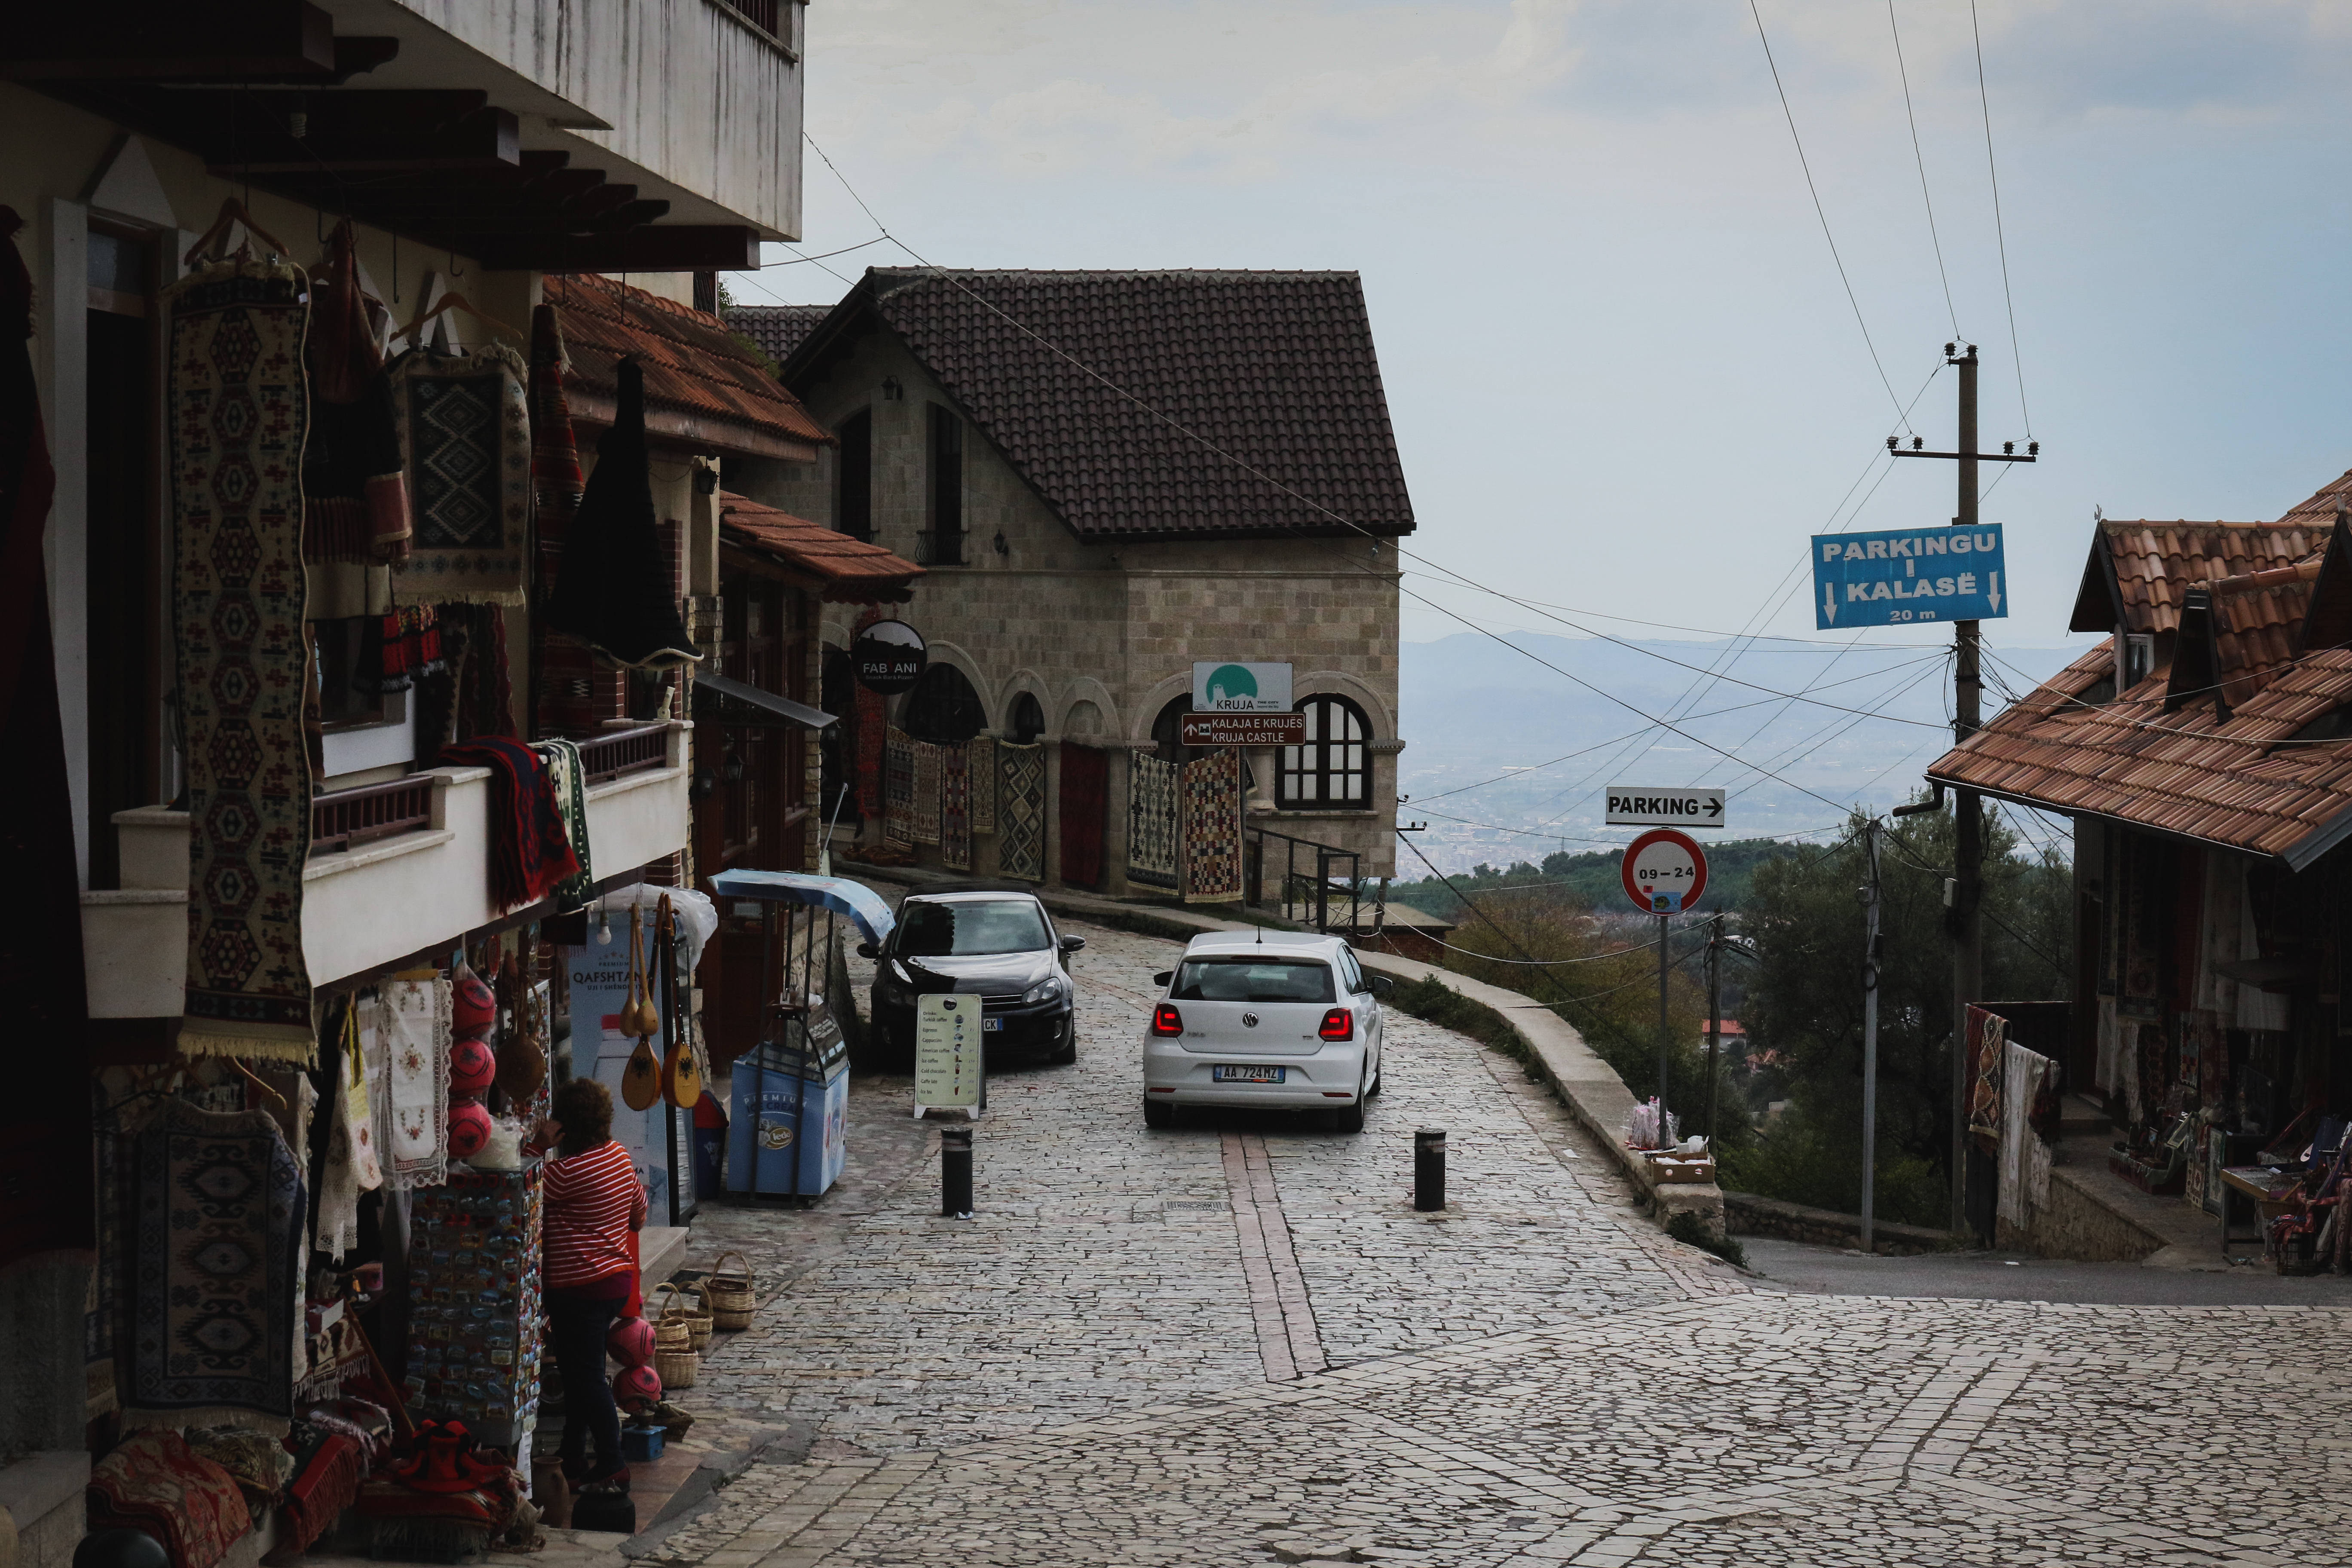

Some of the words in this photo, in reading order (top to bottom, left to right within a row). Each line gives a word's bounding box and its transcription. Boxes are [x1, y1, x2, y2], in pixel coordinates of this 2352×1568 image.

[1823, 533, 1996, 562] PARKINGU
[1906, 559, 1915, 577] I
[1847, 573, 1977, 602] KALASË
[1890, 610, 1913, 621] 20
[1919, 610, 1936, 619] m
[1216, 700, 1254, 710] KRUJA
[1212, 719, 1251, 728] KALAJA
[1254, 719, 1260, 728] E
[1263, 717, 1303, 728] KRUJËS
[1212, 732, 1244, 742] KRUJA
[1247, 732, 1284, 742] CASTLE
[1608, 796, 1698, 815] PARKING
[573, 971, 649, 984] QAFSHTA
[1224, 1067, 1237, 1078] AA
